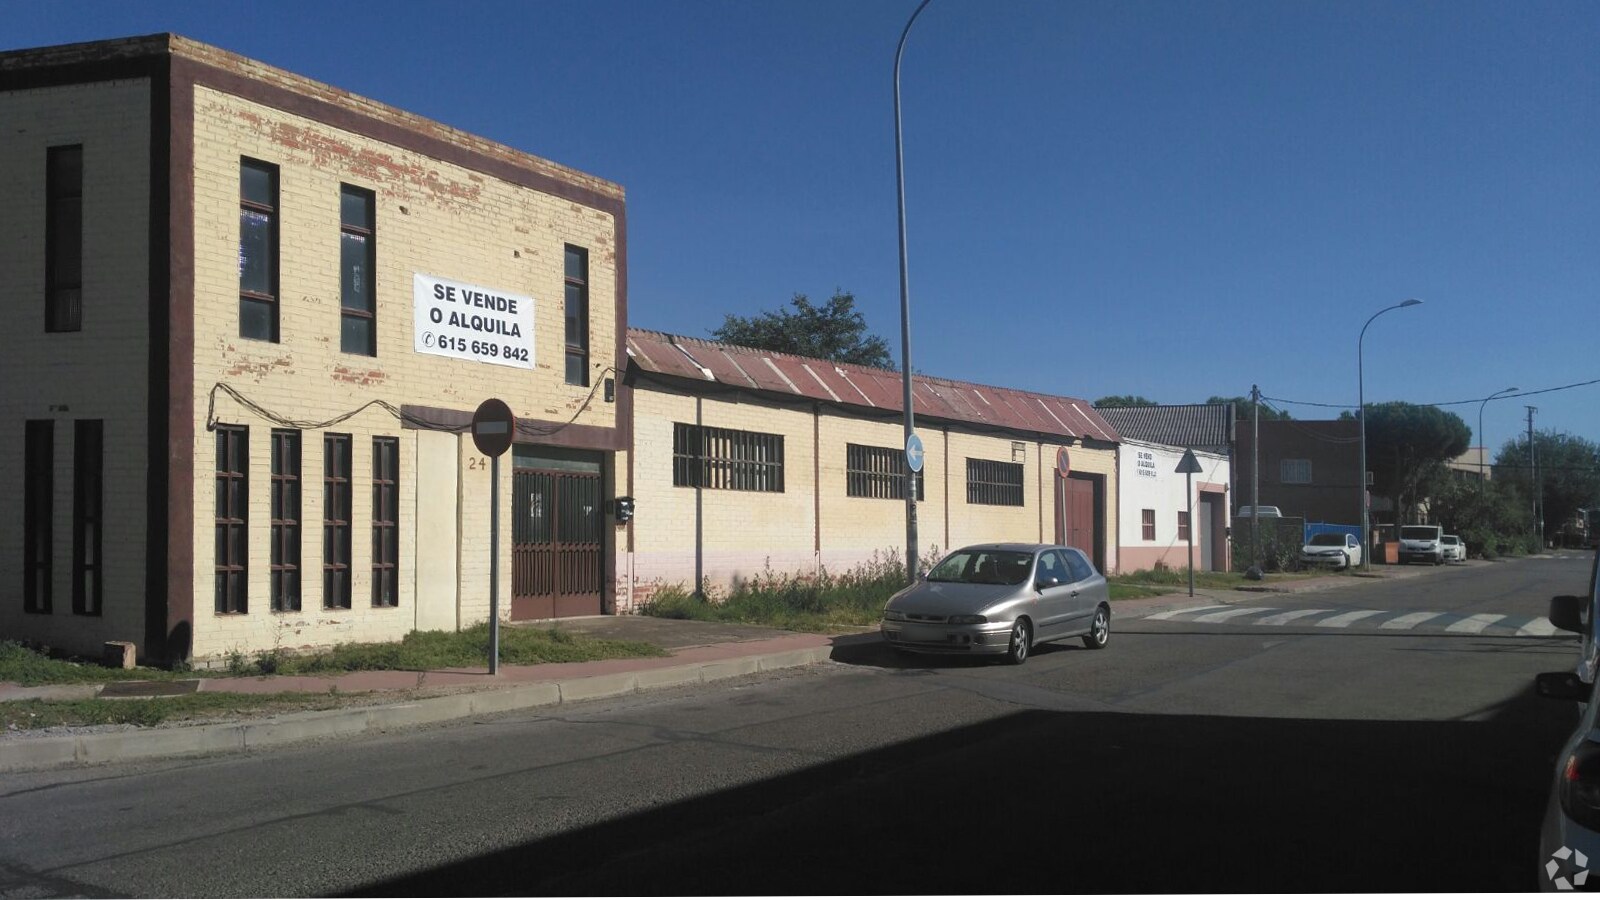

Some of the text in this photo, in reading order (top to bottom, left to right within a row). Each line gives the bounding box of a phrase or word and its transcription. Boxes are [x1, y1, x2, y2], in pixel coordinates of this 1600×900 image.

[433, 283, 518, 315] SE VENDE
[429, 307, 521, 338] O ALQUILA
[438, 334, 529, 362] 615 659 842
[469, 456, 486, 471] 24
